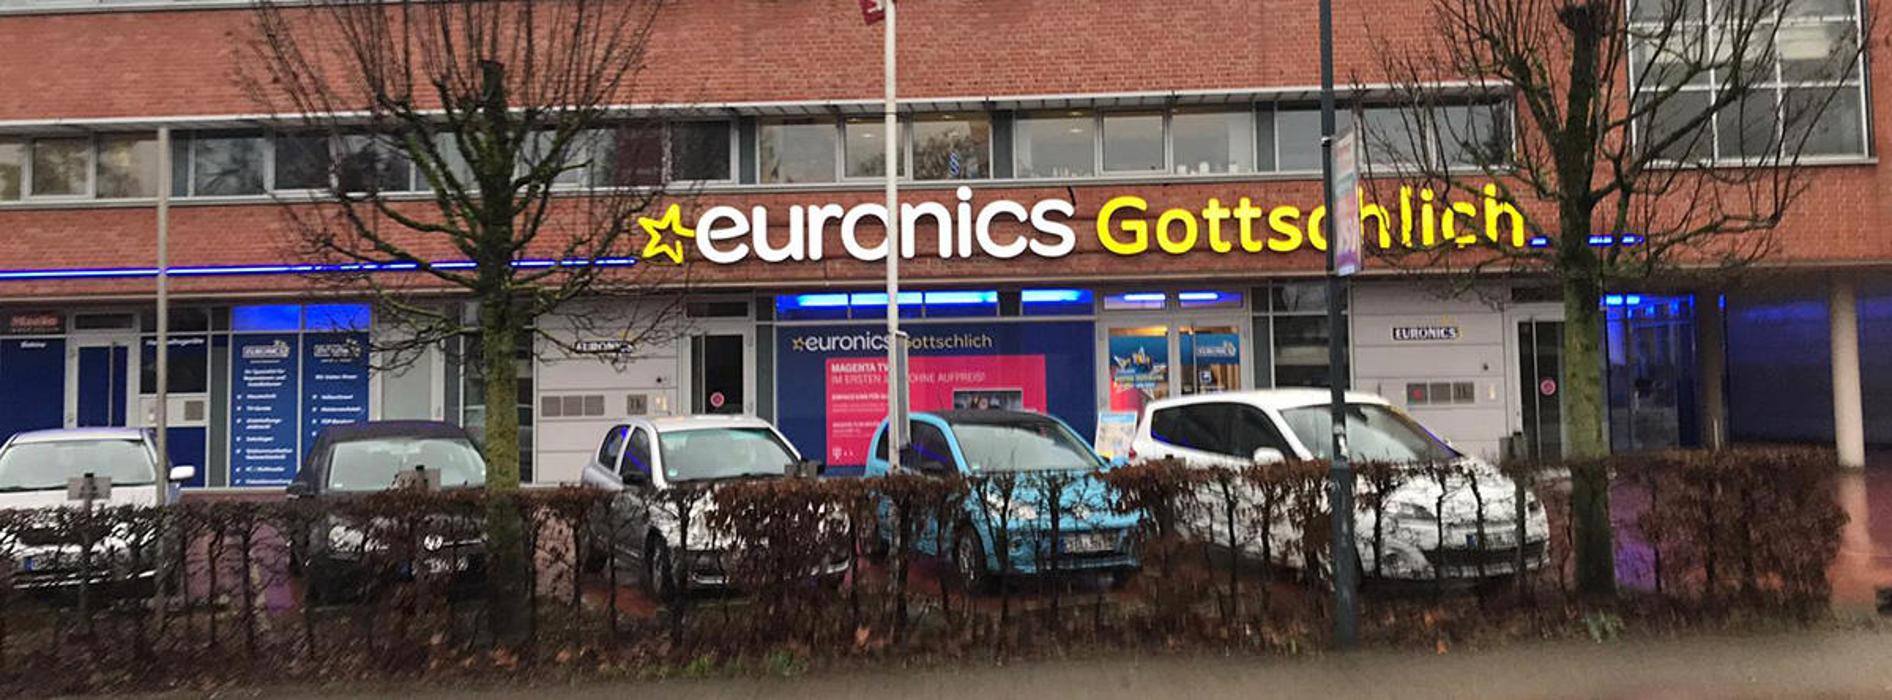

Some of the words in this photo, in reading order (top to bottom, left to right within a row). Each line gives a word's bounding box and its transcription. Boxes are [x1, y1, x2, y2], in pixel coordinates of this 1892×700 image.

[695, 186, 1076, 264] euronics
[1396, 328, 1457, 338] EURONICS
[805, 331, 888, 351] euronics
[831, 363, 876, 373] MAGENTA
[845, 374, 881, 385] ERSTEN
